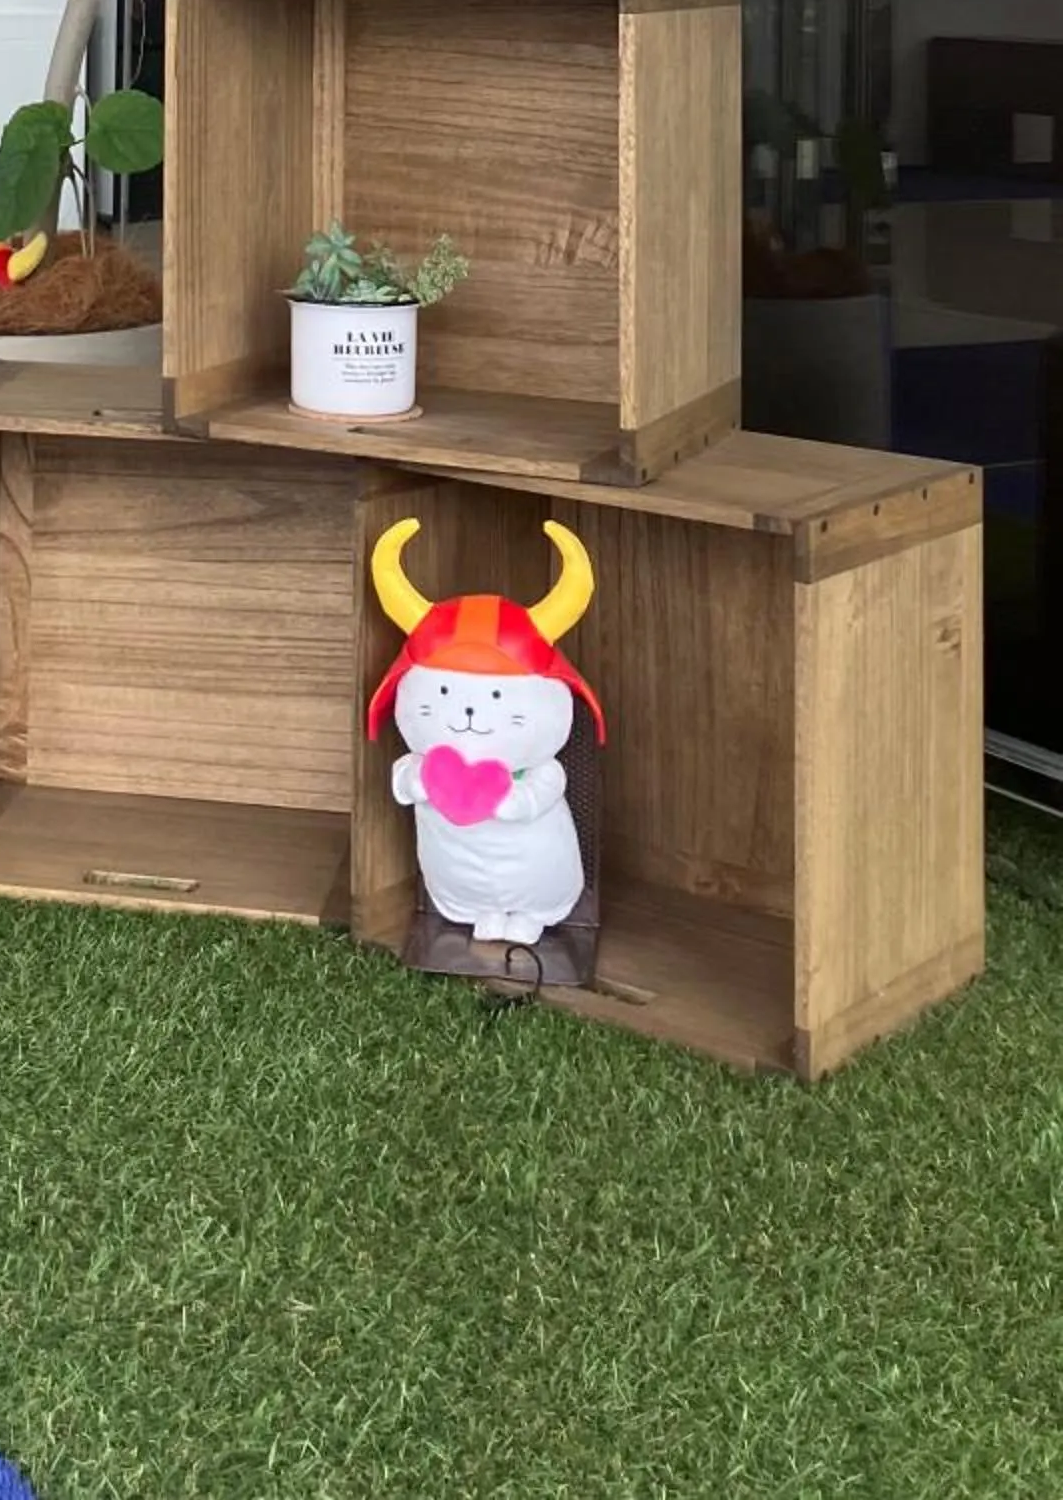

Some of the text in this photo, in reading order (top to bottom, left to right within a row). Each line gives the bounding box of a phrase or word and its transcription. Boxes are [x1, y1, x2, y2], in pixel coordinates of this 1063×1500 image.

[348, 331, 395, 343] LA VIE
[333, 343, 405, 355] HEUREUSE
